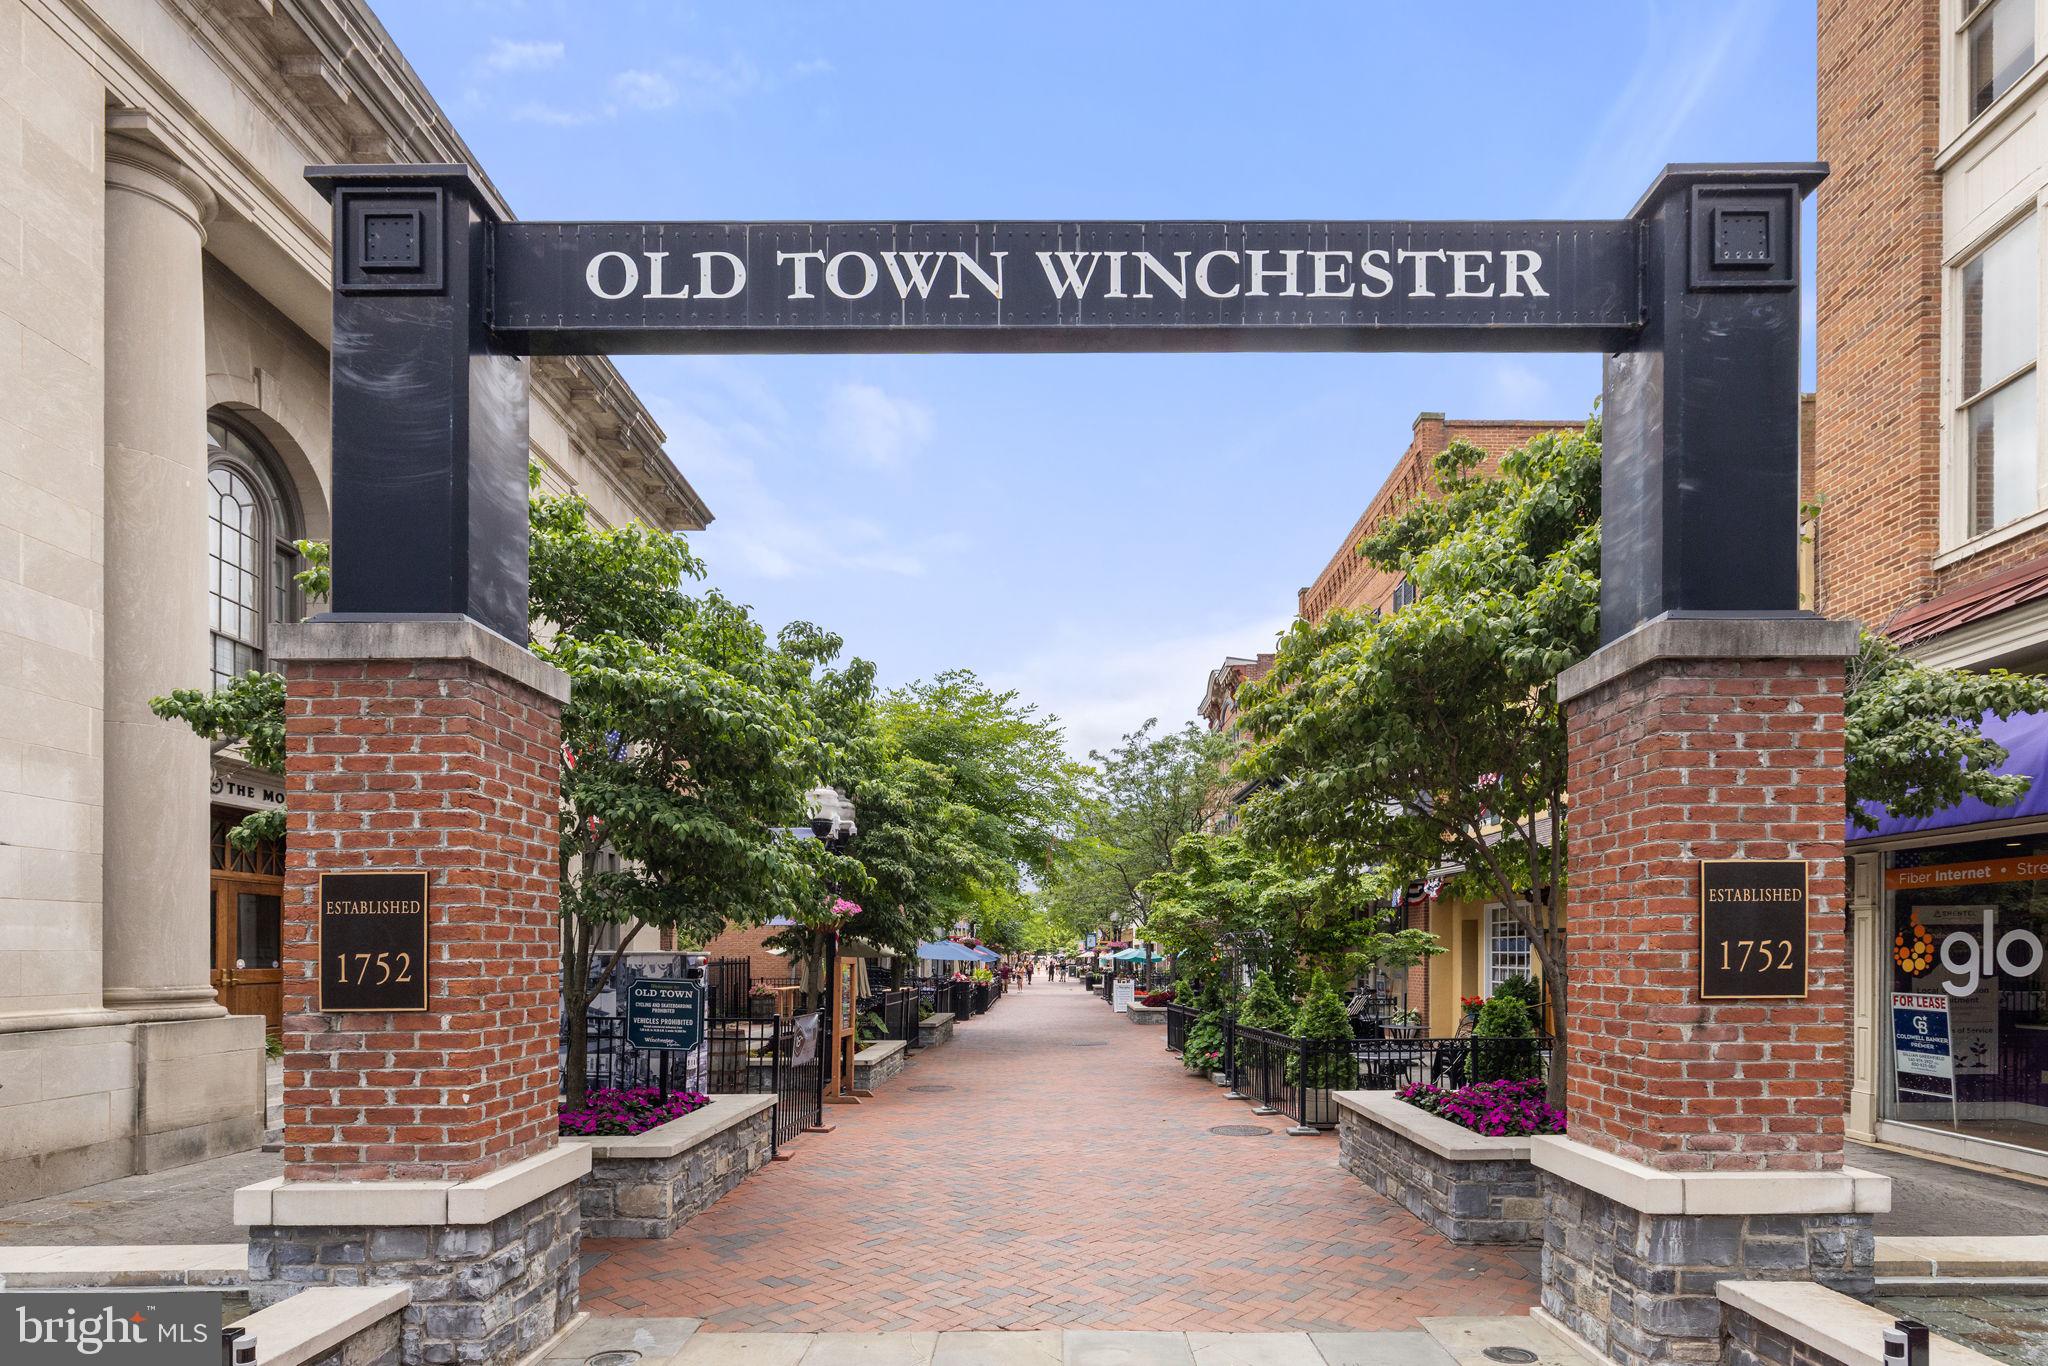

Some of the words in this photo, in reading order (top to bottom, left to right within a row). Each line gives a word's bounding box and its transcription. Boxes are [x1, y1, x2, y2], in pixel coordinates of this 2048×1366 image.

[585, 251, 747, 299] OLD
[776, 249, 1009, 300] TOWN
[1035, 248, 1550, 299] WINCHESTER
[226, 781, 255, 798] THE
[263, 789, 285, 804] MO
[1899, 871, 1932, 884] Fiber
[1935, 865, 1992, 881] Internet
[1709, 888, 1802, 902] ESTABLISHED
[326, 900, 420, 914] ESTABLISHED
[1720, 939, 1794, 973] 1752
[1940, 909, 2044, 997] glo
[337, 952, 412, 985] 1752
[634, 989, 657, 997] OLD
[660, 989, 693, 998] TOWN
[1893, 995, 1913, 1007] FOR
[1916, 996, 1946, 1009] LEASE
[633, 1017, 659, 1025] VEHICLES
[660, 1018, 693, 1026] PROHIBITED
[1896, 1033, 1925, 1041] COLDWELL
[1911, 1041, 1934, 1049] PREMIER
